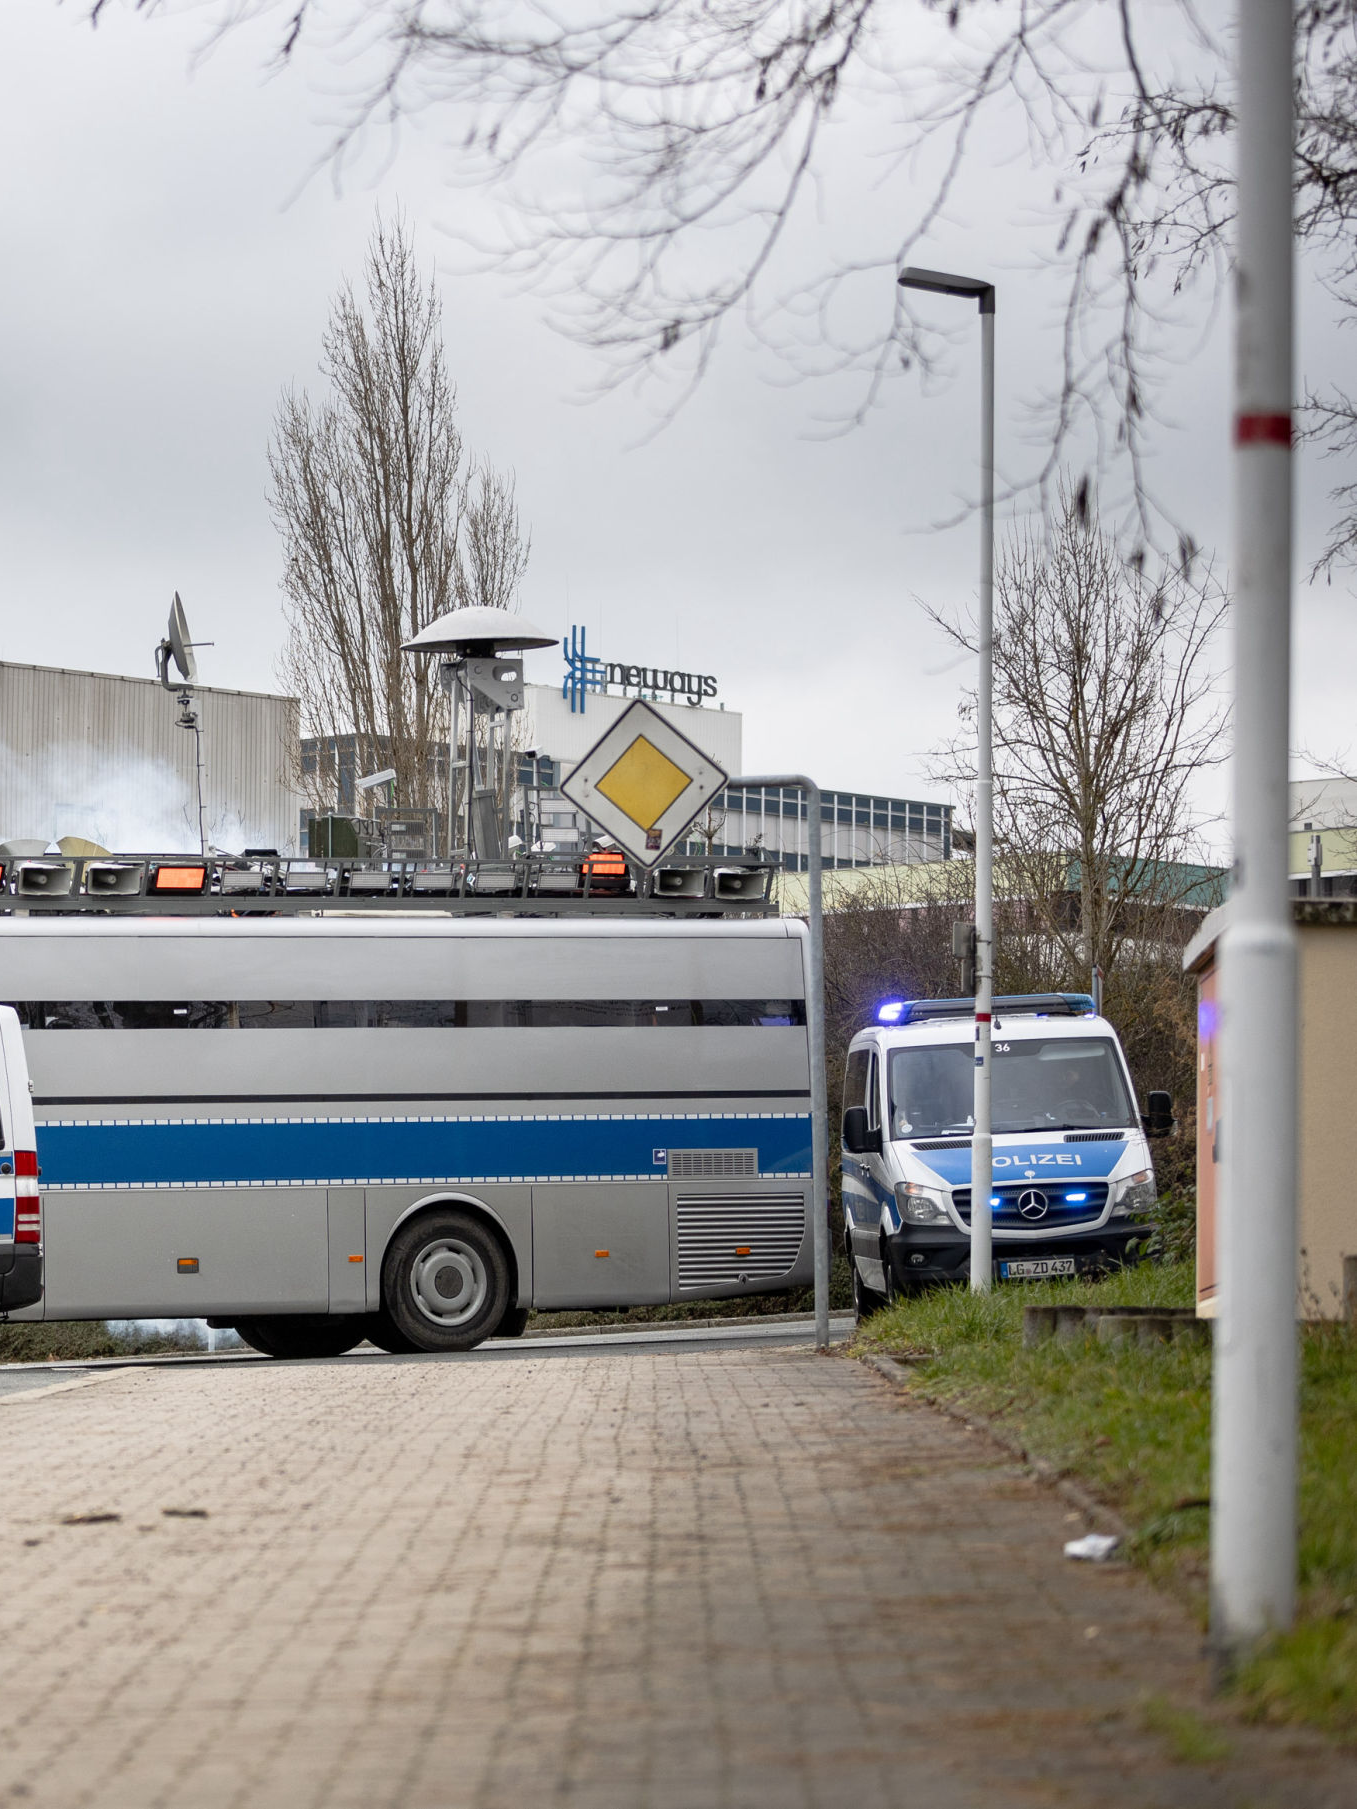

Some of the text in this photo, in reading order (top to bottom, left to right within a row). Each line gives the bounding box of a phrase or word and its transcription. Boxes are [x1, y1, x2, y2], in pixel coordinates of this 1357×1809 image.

[608, 662, 718, 706] neways
[994, 1043, 1011, 1052] 36
[991, 1154, 1082, 1168] OLIZEI
[1008, 1260, 1073, 1276] LG ZD 437
